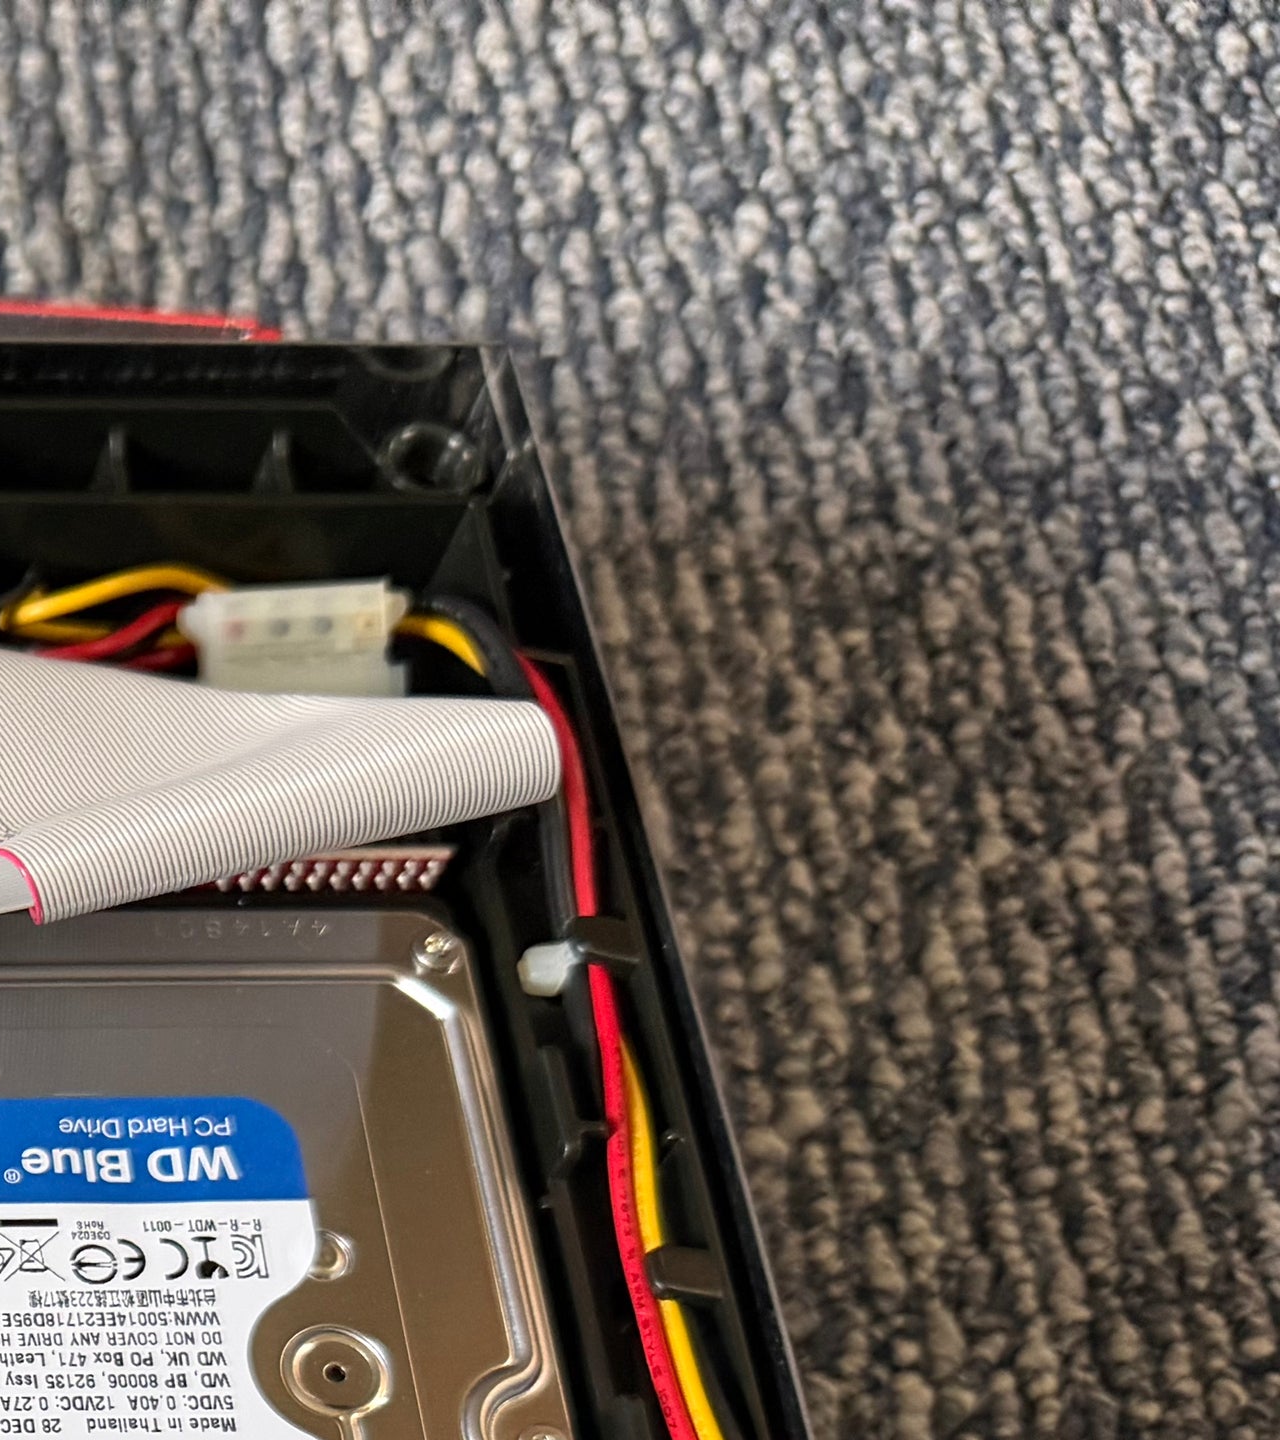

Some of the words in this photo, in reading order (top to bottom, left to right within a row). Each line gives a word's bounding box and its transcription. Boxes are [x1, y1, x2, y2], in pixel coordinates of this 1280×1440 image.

[59, 1119, 122, 1138] Drive
[128, 1117, 188, 1138] Hard
[194, 1117, 232, 1136] PC
[147, 1146, 239, 1182] WD
[2, 1312, 220, 1327] WWN:50014EE21718D95E
[18, 1333, 63, 1346] DRIVE
[71, 1332, 100, 1345] ANY
[106, 1332, 157, 1346] COVER
[166, 1332, 195, 1345] NOT
[202, 1331, 222, 1345] DO
[52, 1350, 86, 1367] 471,
[93, 1352, 124, 1366] Box
[131, 1352, 153, 1366] PO
[161, 1350, 190, 1366] UK,
[198, 1352, 227, 1366] WD
[6, 1371, 38, 1389] Issy
[46, 1374, 95, 1389] 92135
[102, 1372, 158, 1388] 80006,
[165, 1374, 187, 1388] BP
[195, 1371, 231, 1388] WD,
[0, 1397, 48, 1411] 0.27A
[55, 1396, 115, 1411] 12VDC:
[127, 1396, 176, 1410] 0.40A
[183, 1395, 233, 1410] 5VDC:
[0, 1419, 35, 1433] DEC
[42, 1418, 61, 1433] 28
[87, 1418, 162, 1433] Thailand
[168, 1418, 182, 1432] in
[190, 1418, 236, 1432] Made
